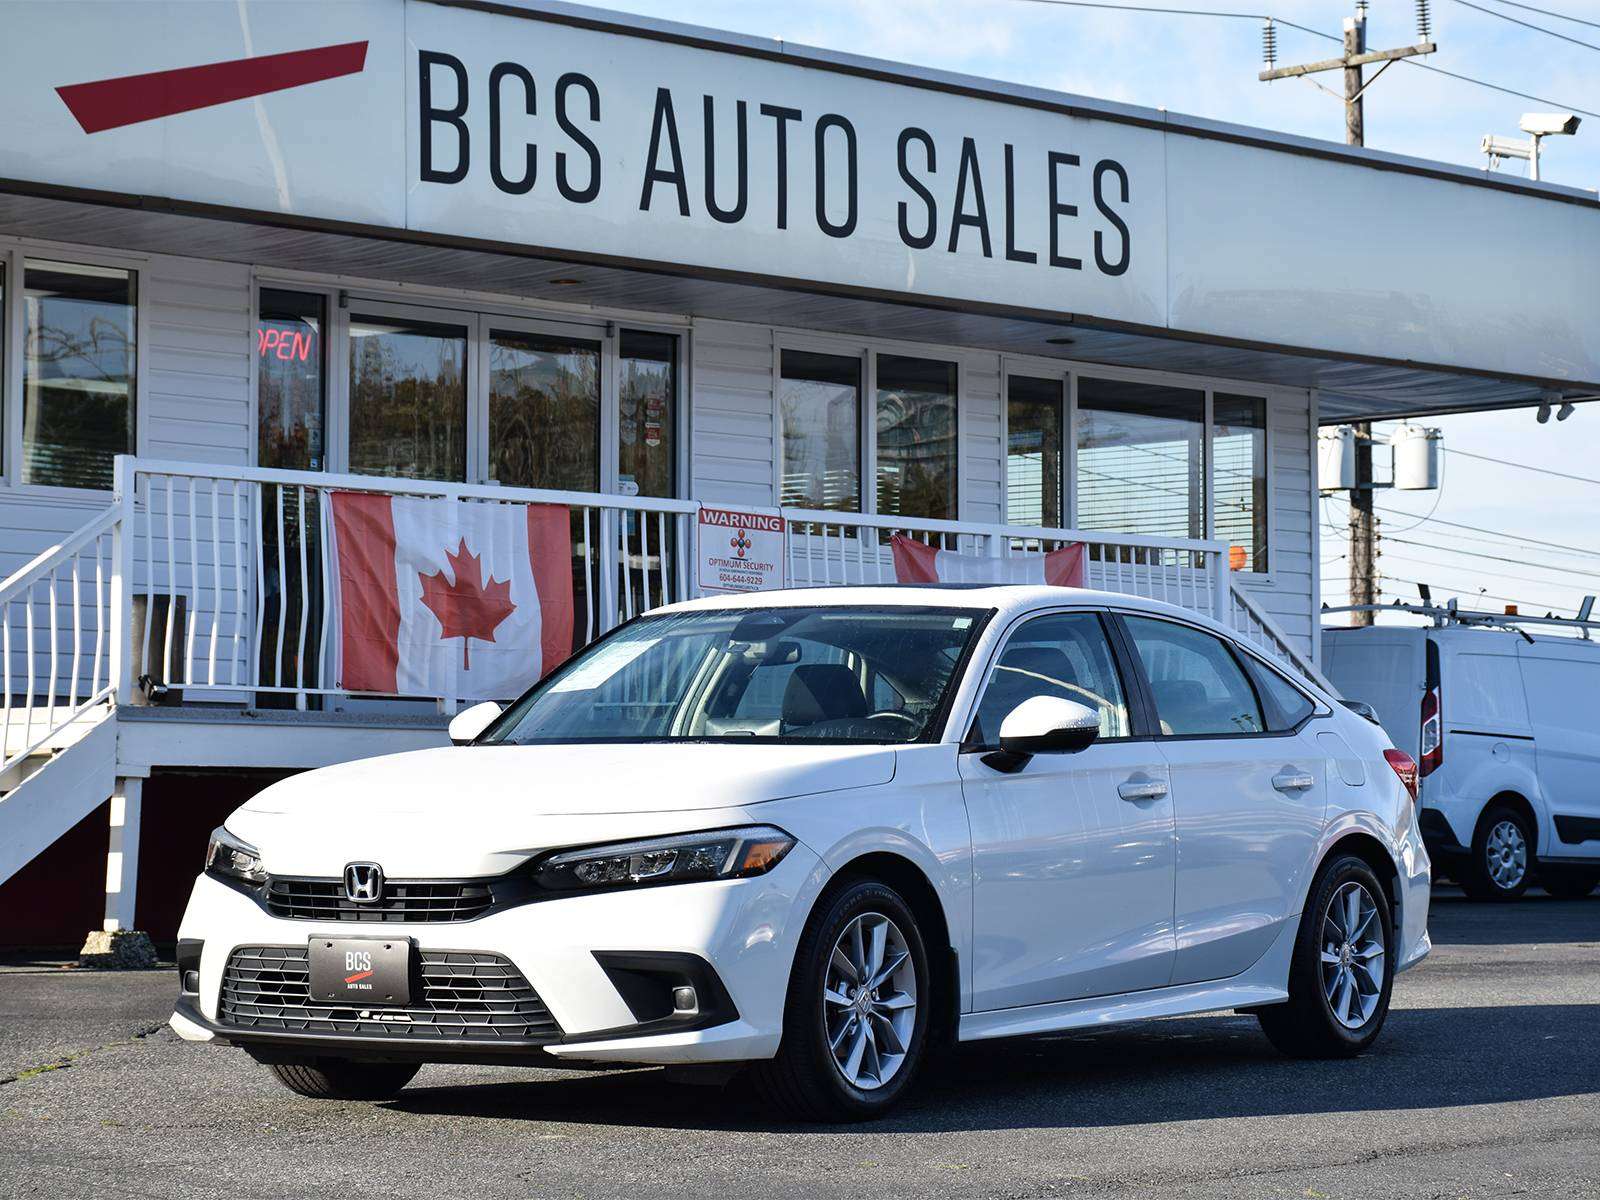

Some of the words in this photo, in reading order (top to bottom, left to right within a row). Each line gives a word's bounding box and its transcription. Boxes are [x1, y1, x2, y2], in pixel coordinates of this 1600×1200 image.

[419, 50, 601, 204] BCS
[640, 88, 858, 239] AUTO
[898, 128, 1130, 277] SALES
[702, 510, 780, 531] WARNING
[708, 557, 742, 569] OPTIMUM
[743, 561, 774, 572] SECURITY
[345, 951, 371, 971] BCS
